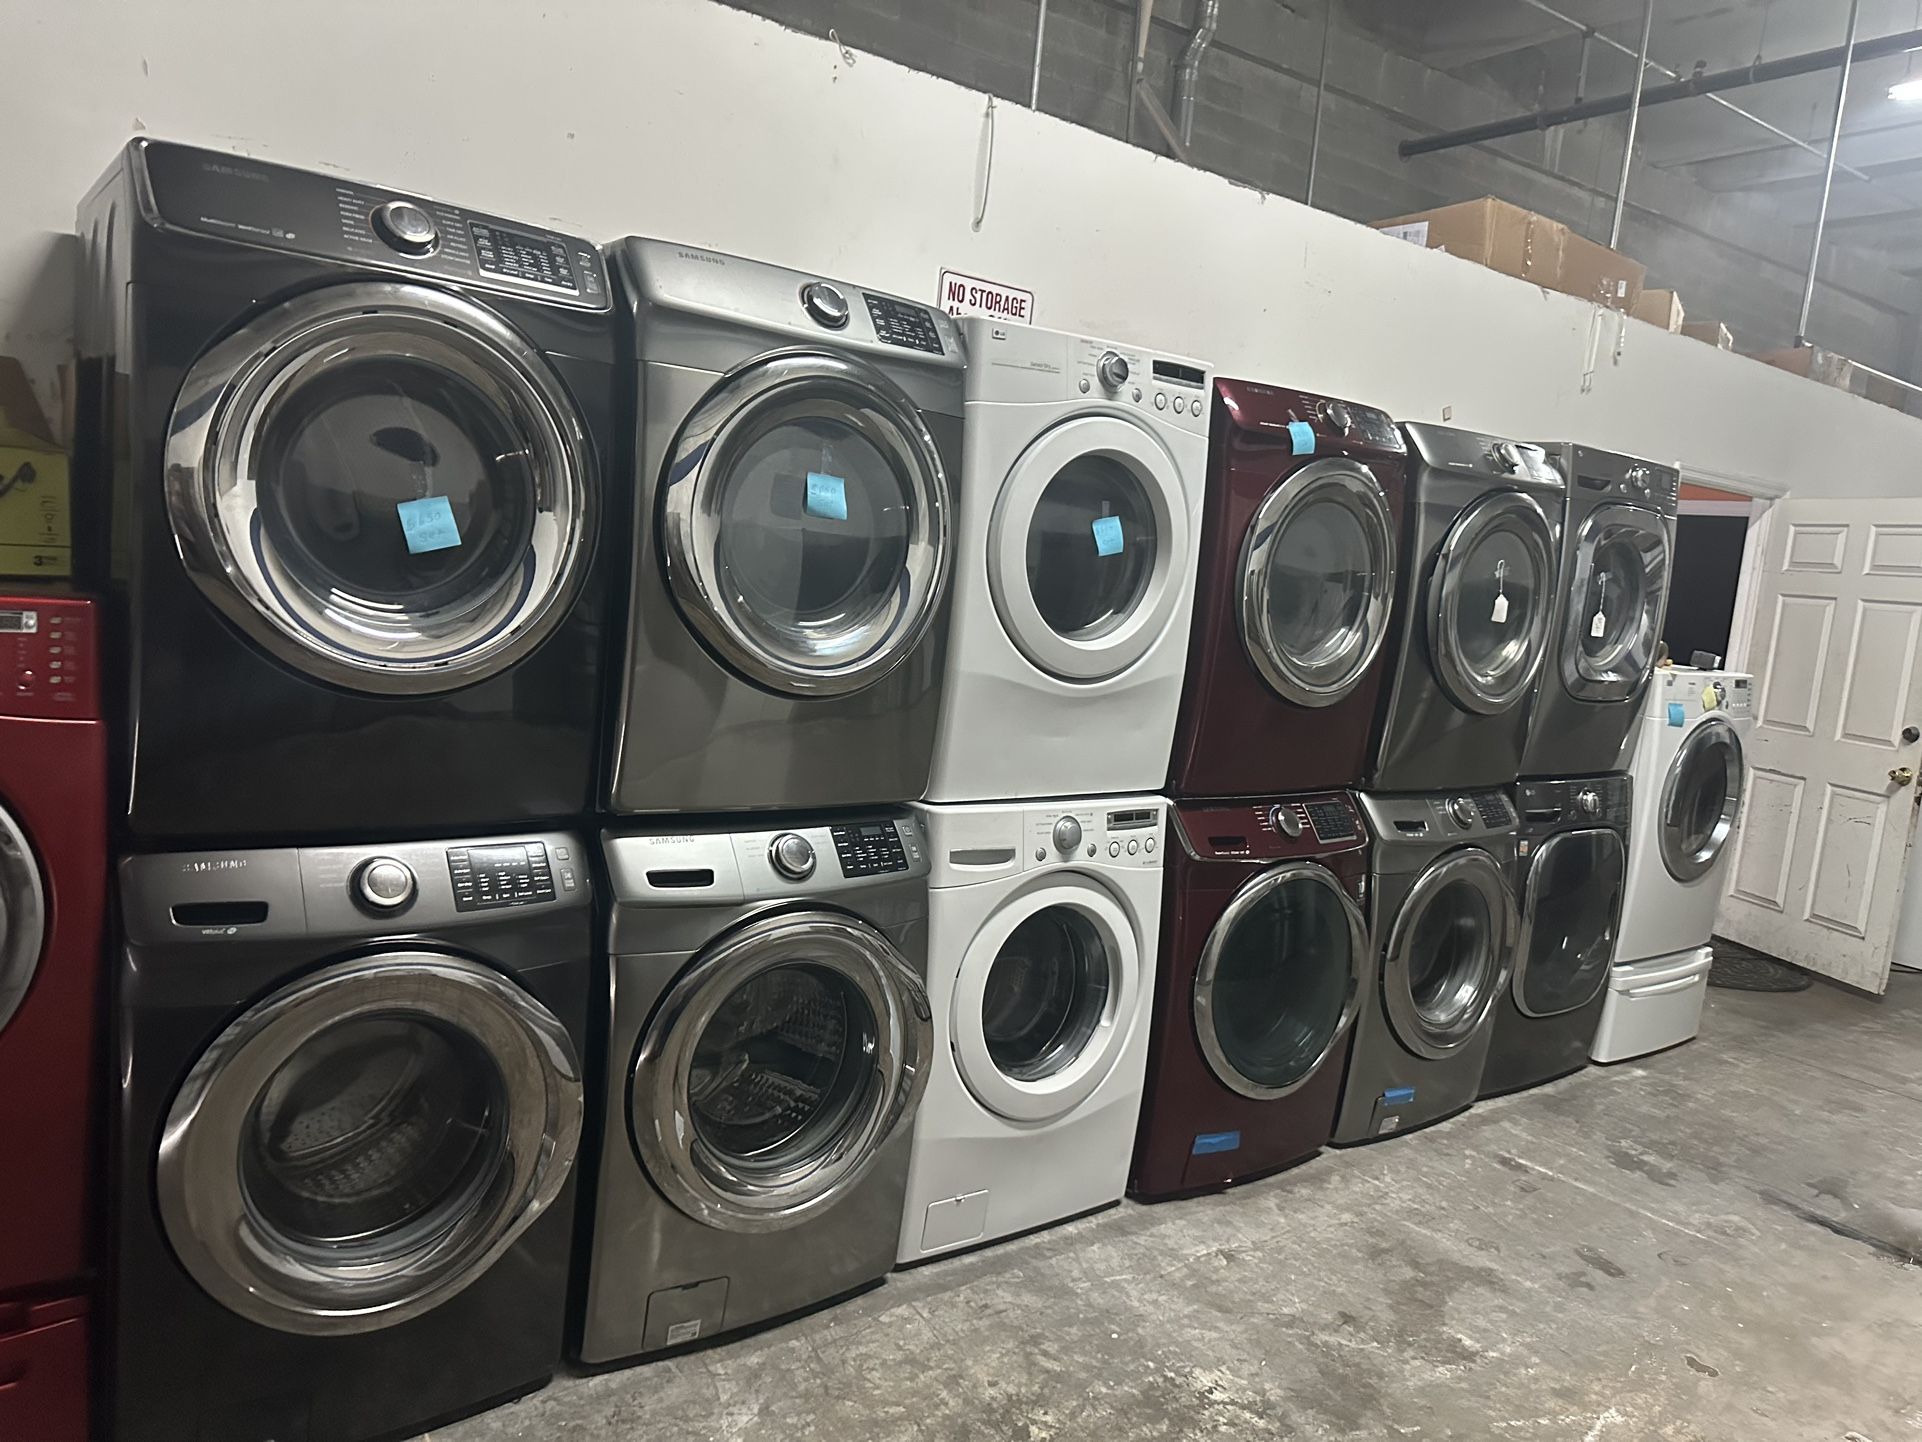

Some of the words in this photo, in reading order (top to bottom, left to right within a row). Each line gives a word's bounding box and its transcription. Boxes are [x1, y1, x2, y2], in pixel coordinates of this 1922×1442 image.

[678, 252, 725, 265] SAMSUNG
[947, 281, 965, 304] NO
[969, 287, 1027, 318] STORAGE
[649, 835, 695, 845] SAMSUNG
